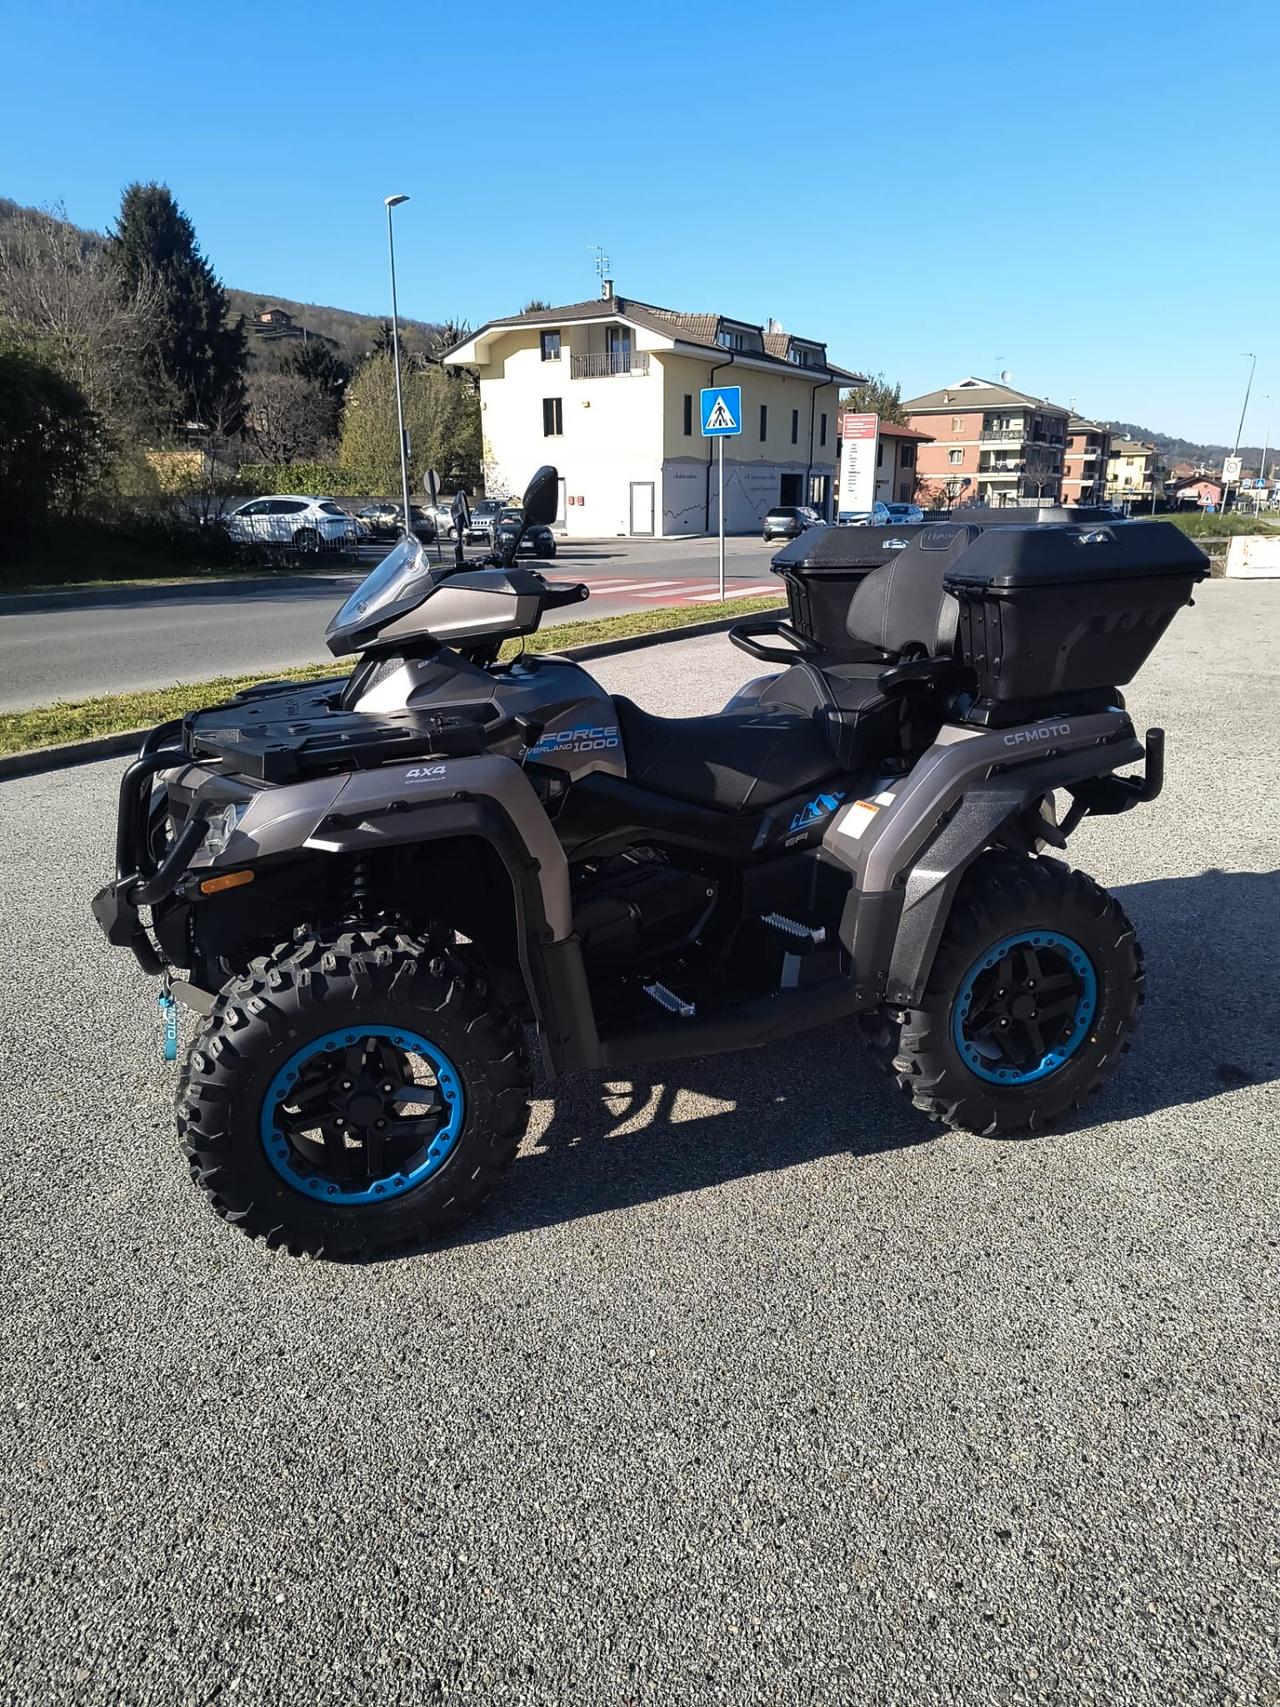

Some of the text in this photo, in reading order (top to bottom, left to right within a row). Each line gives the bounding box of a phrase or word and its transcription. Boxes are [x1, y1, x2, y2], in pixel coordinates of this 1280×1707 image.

[536, 726, 618, 745] FORCE
[1003, 724, 1071, 746] CFMOTO
[573, 738, 618, 753] 1000
